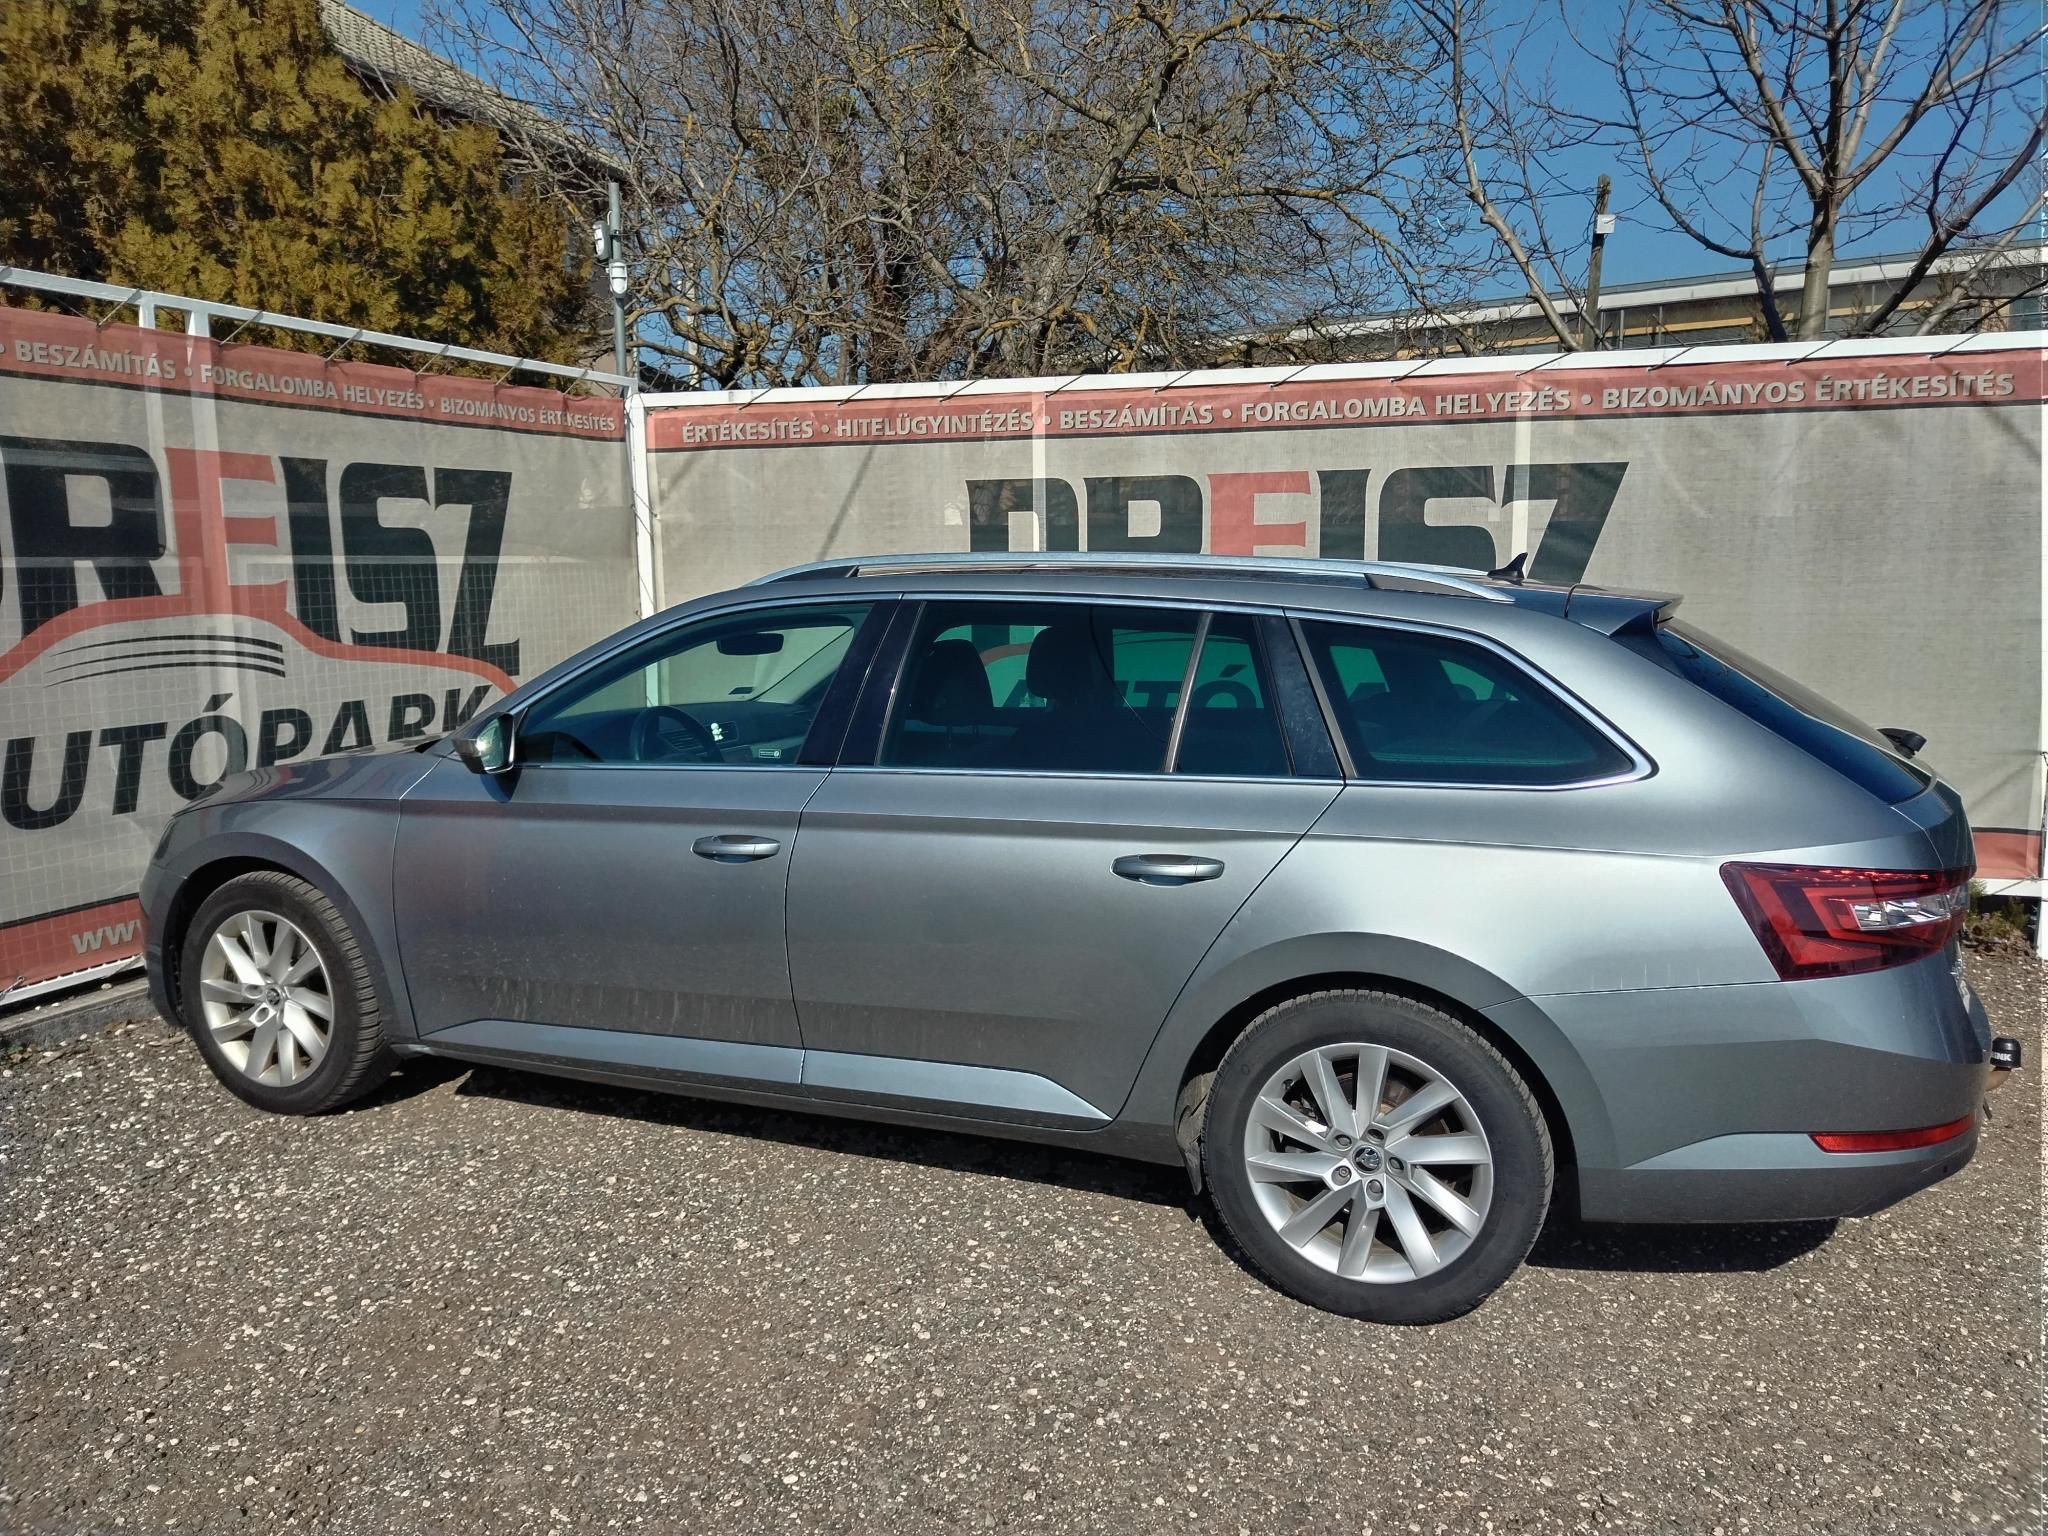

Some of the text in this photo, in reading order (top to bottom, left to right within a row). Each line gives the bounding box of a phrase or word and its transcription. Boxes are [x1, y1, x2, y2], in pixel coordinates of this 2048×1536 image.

[15, 339, 176, 380] BESZÁMÍTÁS
[200, 364, 338, 400] FORGALOMBA
[343, 384, 424, 410] HELYEZÉS
[440, 398, 536, 424] BIZOMÁNYOS
[682, 372, 2016, 444] ÉRTÉKESÍTÉS HITELÜGYINTÉZÉS BESZÁMÍTÁS FORGALOMBA HELYEZÉS BIZOMÁNYOS ÉRTÉKESÍTÉS
[0, 436, 520, 677] REISZ
[0, 684, 493, 831] UTÓPARK
